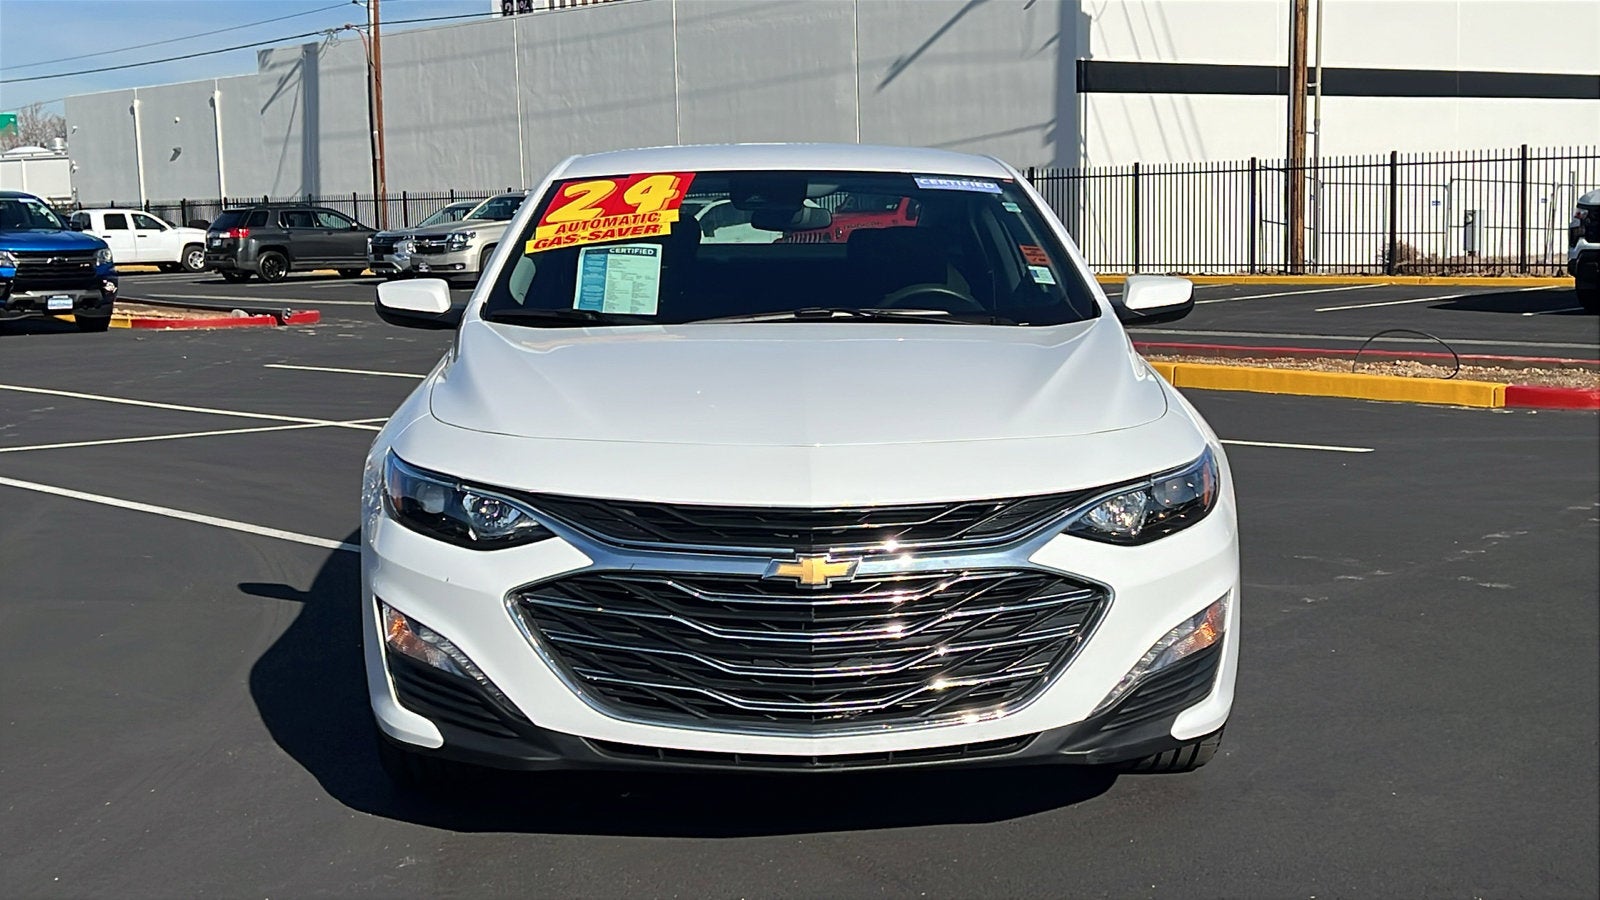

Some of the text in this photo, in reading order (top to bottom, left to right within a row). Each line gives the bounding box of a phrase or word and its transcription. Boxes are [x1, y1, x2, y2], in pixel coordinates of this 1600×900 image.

[919, 178, 996, 189] CERTIFIED
[545, 175, 680, 222] 24
[555, 212, 660, 234] AUTOMATIC
[533, 223, 662, 249] GAS-SAVER
[608, 247, 655, 255] CERTIFIED
